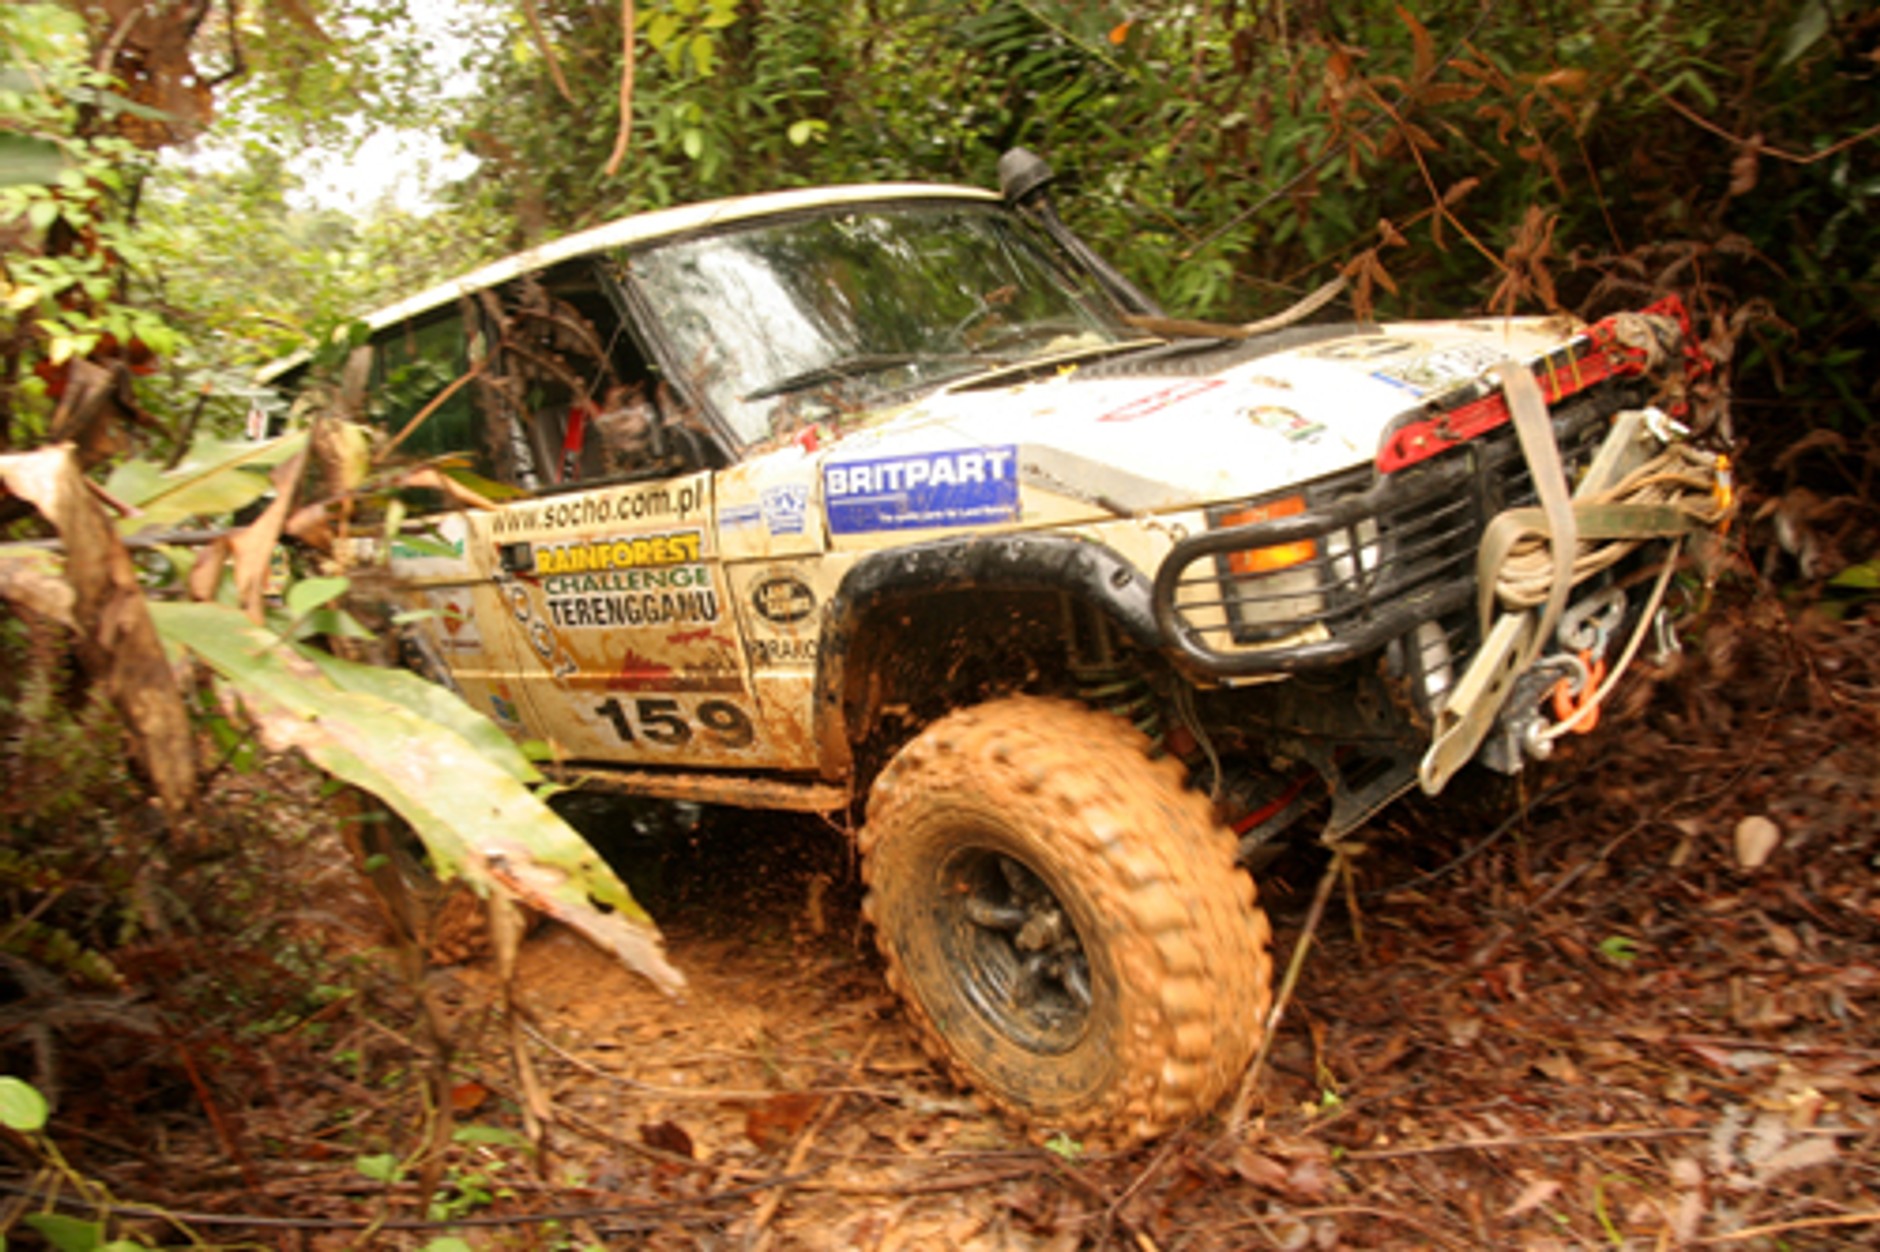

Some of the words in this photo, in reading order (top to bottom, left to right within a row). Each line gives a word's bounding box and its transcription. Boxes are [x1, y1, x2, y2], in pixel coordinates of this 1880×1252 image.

[827, 451, 1011, 495] BRITPART
[492, 478, 704, 534] www.socho.com.pl
[536, 531, 701, 574] RAINFOREST
[545, 566, 710, 594] CHALLENGE
[549, 590, 718, 625] TERENGGANU
[594, 699, 754, 749] 159
